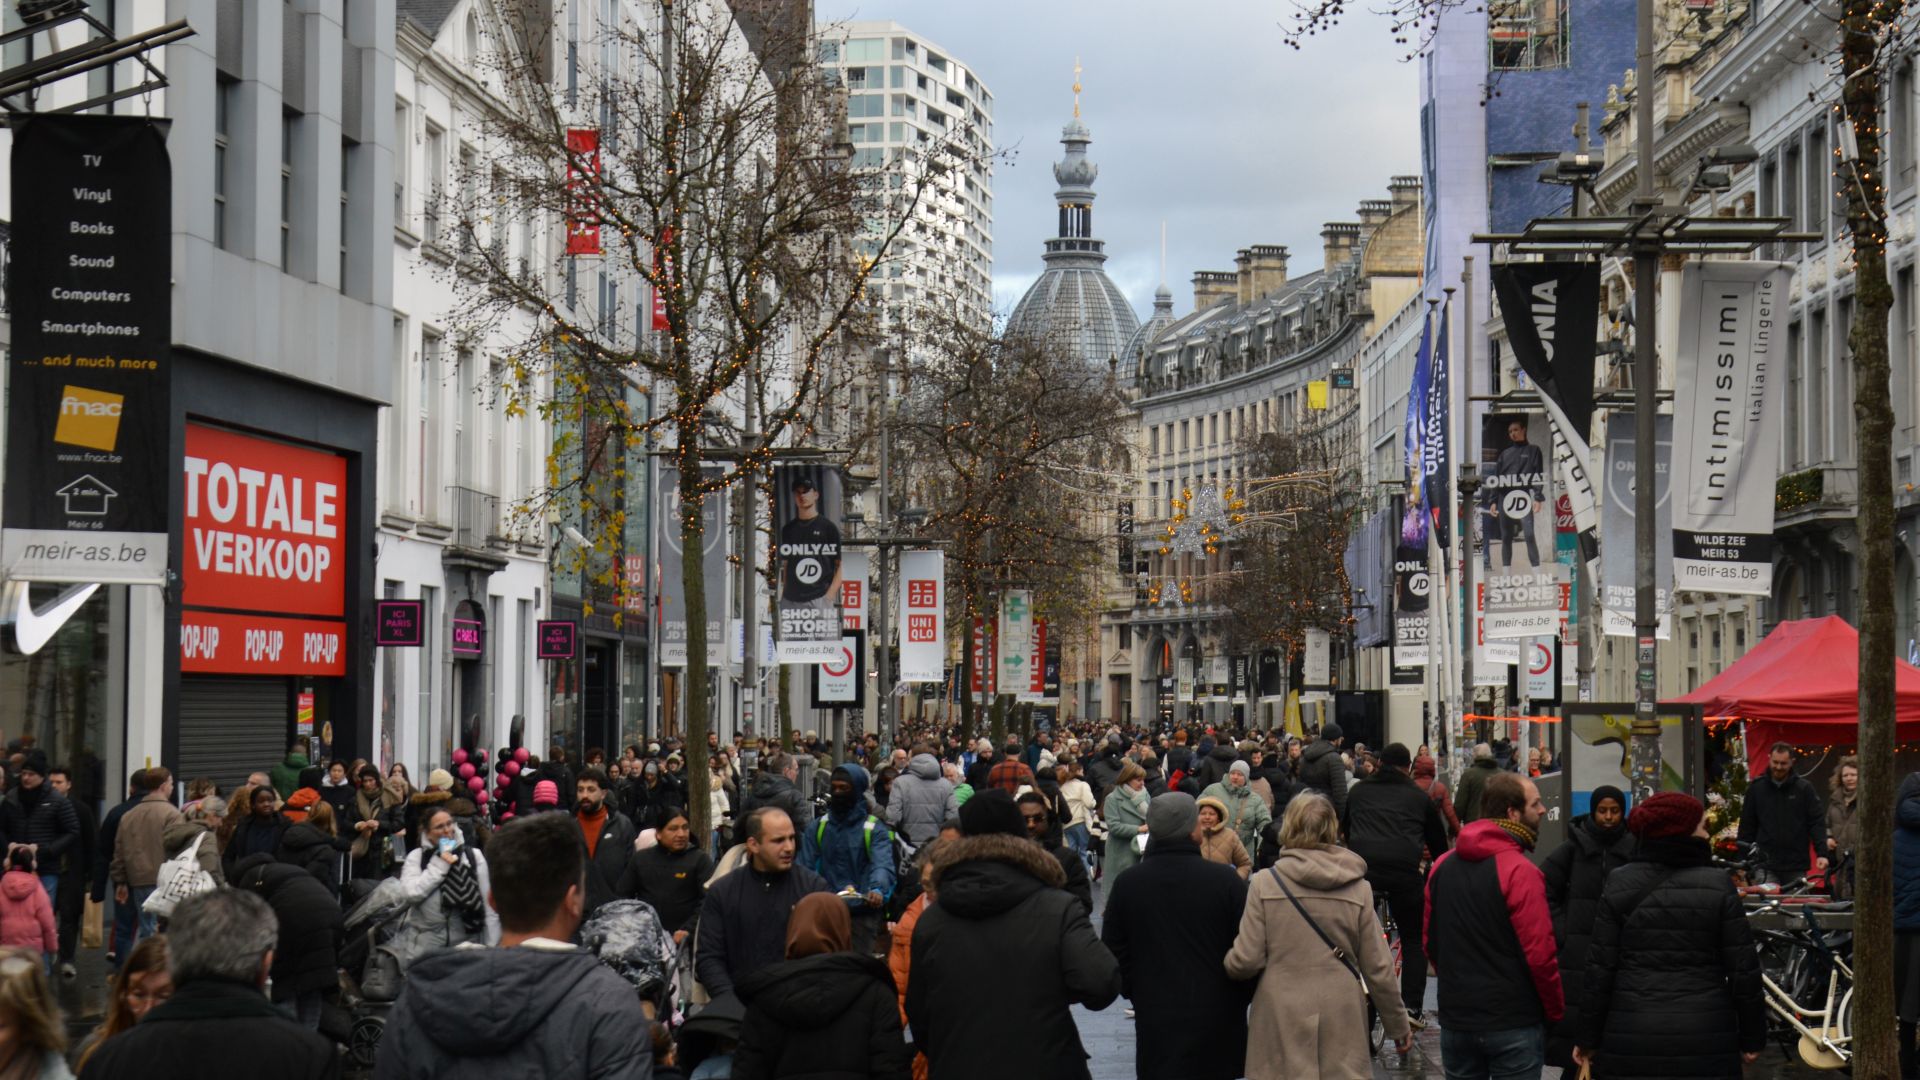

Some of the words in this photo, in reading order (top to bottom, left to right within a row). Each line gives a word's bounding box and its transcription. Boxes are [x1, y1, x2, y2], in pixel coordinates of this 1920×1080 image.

[83, 154, 102, 166] TV
[73, 188, 112, 203] Vinyl
[70, 222, 115, 235] Books
[69, 254, 115, 268] Sound
[52, 287, 131, 302] Computers
[1757, 280, 1773, 355] lingerie
[41, 320, 140, 336] Smartphones
[42, 354, 72, 366] and
[76, 355, 116, 368] much
[120, 358, 158, 370] more
[1750, 363, 1766, 422] Italian
[60, 396, 122, 417] fnac
[57, 452, 123, 464] www.fnac.be
[1616, 460, 1636, 471] ON
[1486, 474, 1532, 489] ONLY
[73, 487, 80, 496] 2
[184, 456, 337, 538] TOTALE
[1508, 496, 1528, 512] JD
[67, 520, 90, 528] Meir
[1694, 535, 1726, 545] WILDE
[1728, 536, 1746, 546] ZEE
[24, 540, 147, 562] meir-as.be
[193, 528, 330, 583] VERKOOP
[780, 543, 822, 556] ONLY
[1701, 548, 1726, 558] MEIR
[1728, 549, 1740, 558] 53
[800, 564, 819, 577] JD
[1394, 560, 1428, 572] ONL
[1686, 564, 1759, 580] meir-as.be
[1412, 578, 1428, 590] JD
[1490, 575, 1534, 588] SHOP
[1536, 574, 1552, 586] IN
[1490, 586, 1554, 602] STORE
[1608, 585, 1636, 597] FIND
[1608, 596, 1622, 606] JD
[782, 608, 820, 620] SHOP
[822, 608, 838, 618] IN
[386, 620, 412, 628] PARIS
[666, 620, 686, 630] FIN
[782, 620, 838, 632] STORE
[912, 618, 932, 628] UNI
[1495, 616, 1550, 628] meir-as.be
[666, 630, 680, 640] JD
[912, 628, 934, 640] QLO
[1398, 628, 1428, 638] STO
[245, 629, 284, 662] POP-UP
[304, 632, 339, 664] POP-UP
[785, 645, 834, 655] meir-as.be
[1490, 648, 1520, 656] meir-as.
[974, 625, 994, 688] HEMA
